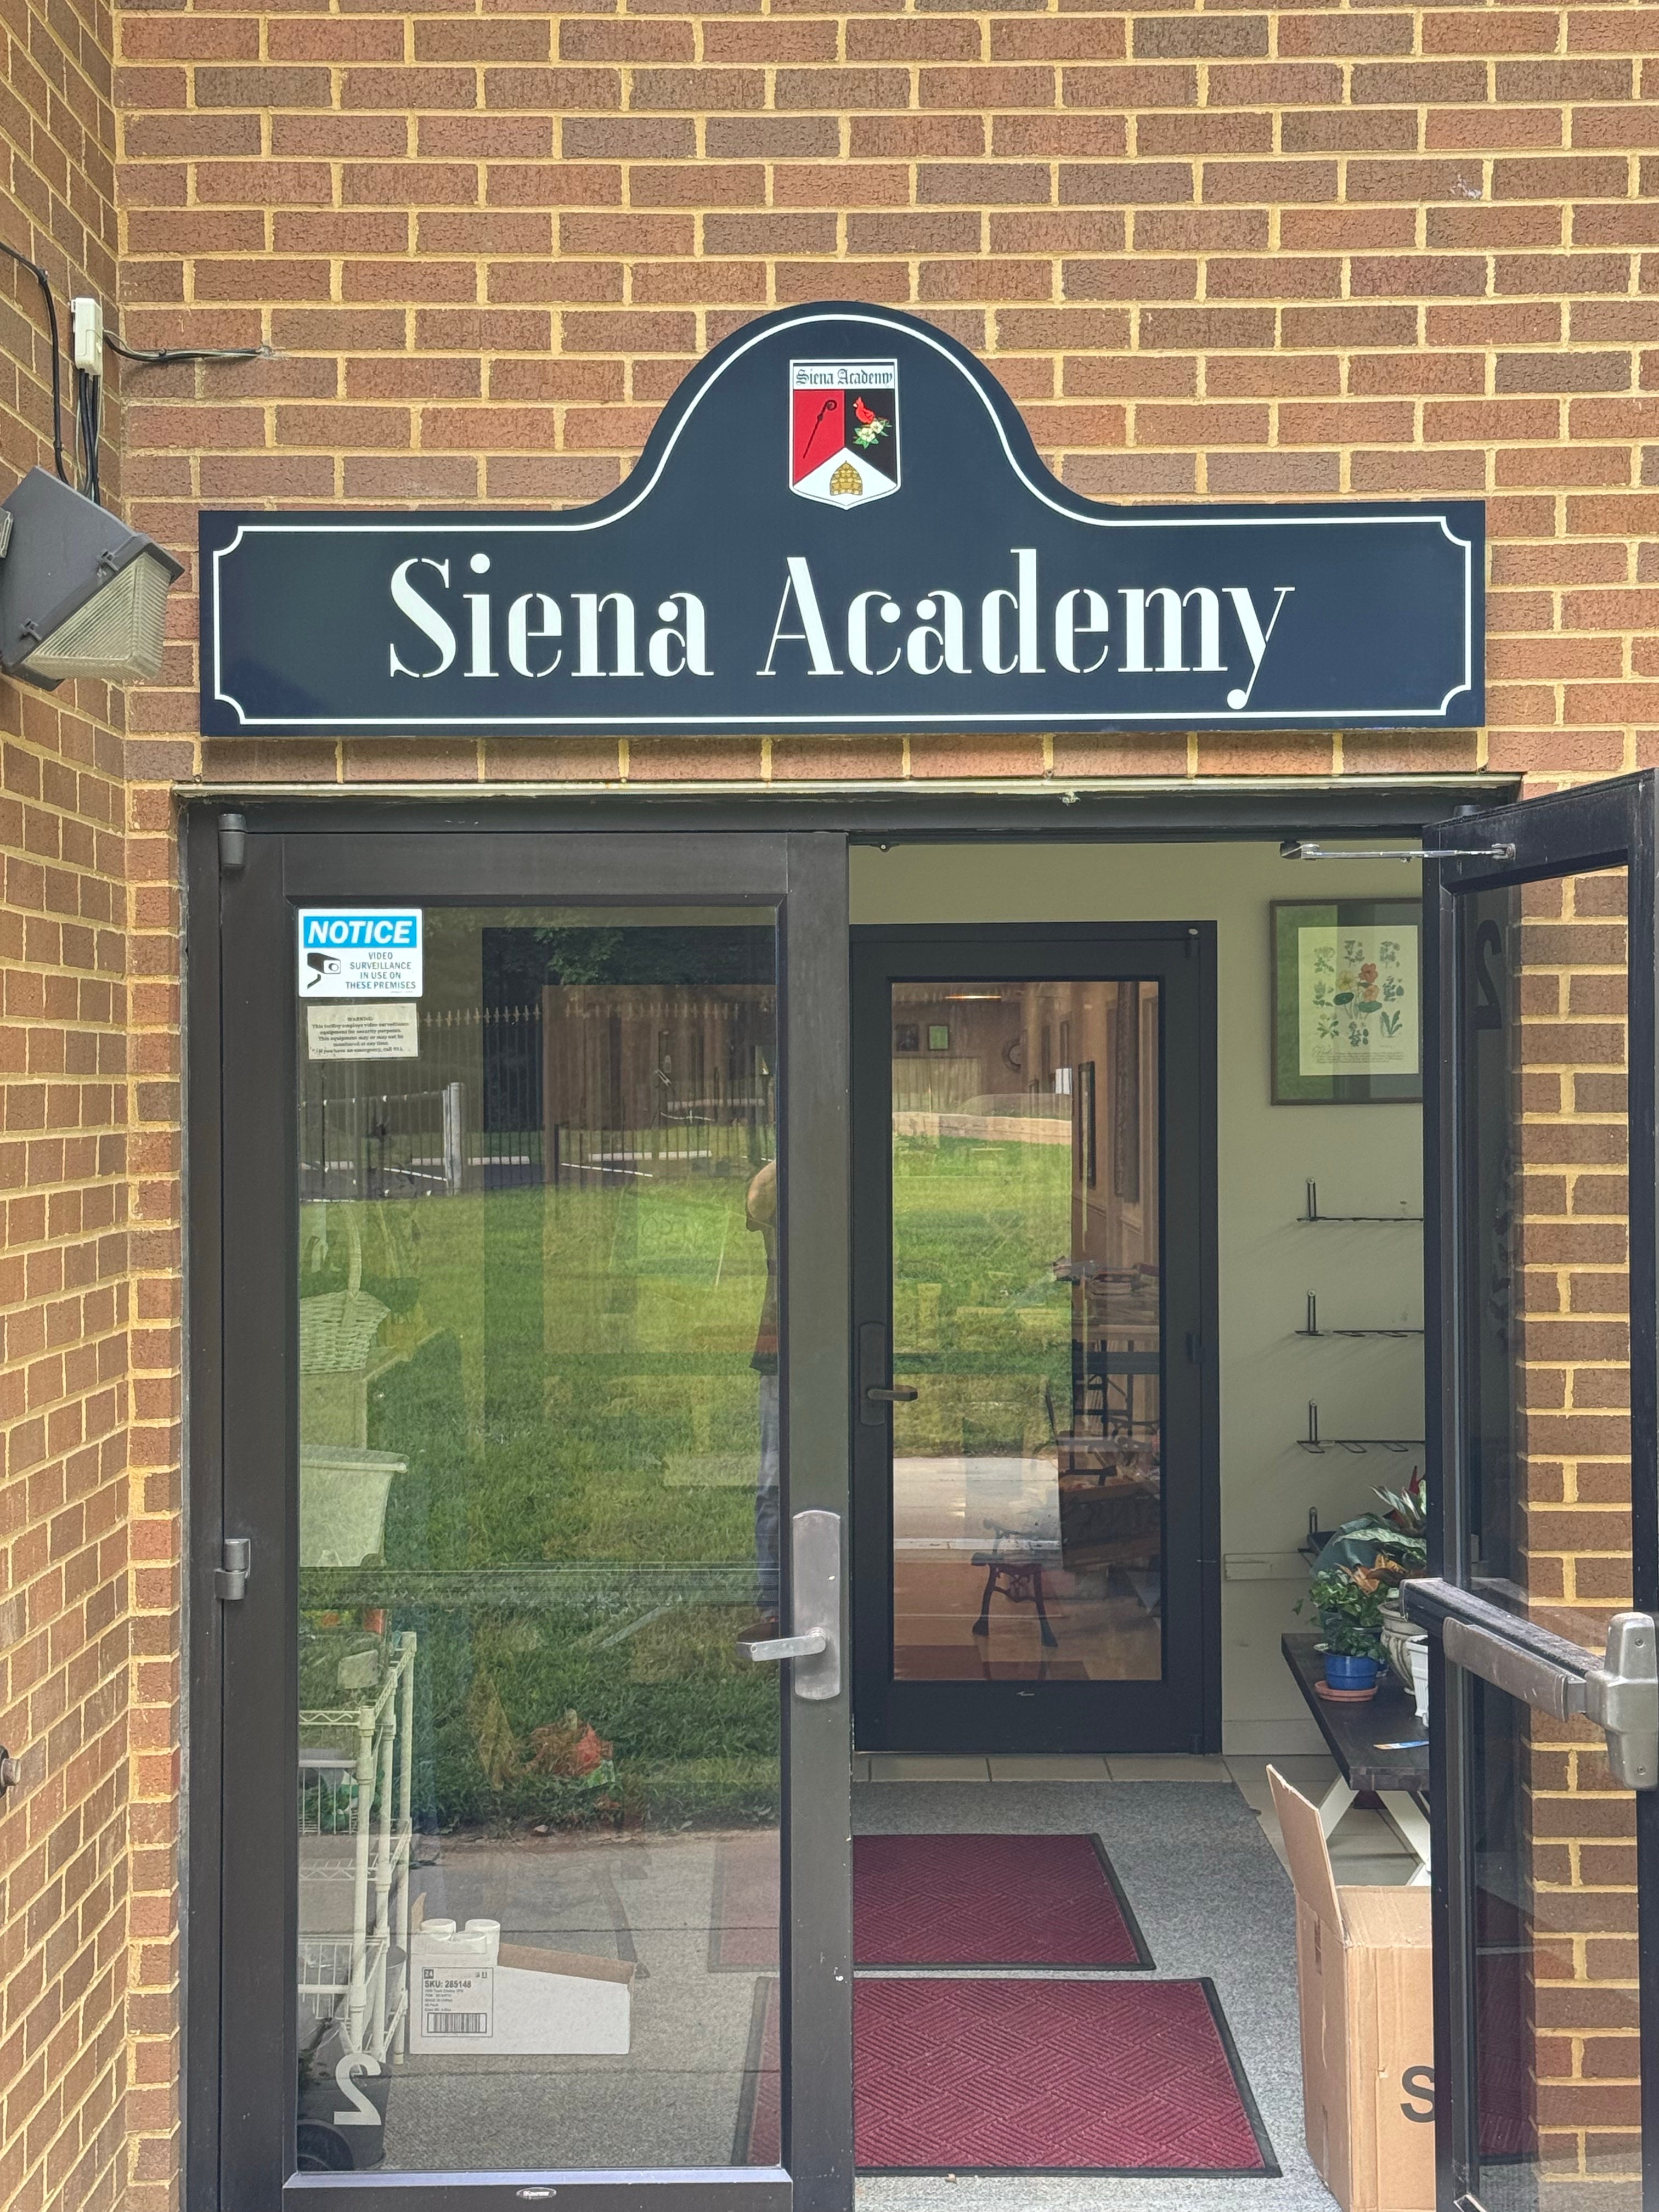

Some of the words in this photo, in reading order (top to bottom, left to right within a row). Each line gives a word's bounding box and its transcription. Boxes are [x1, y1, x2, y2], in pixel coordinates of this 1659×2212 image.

[795, 368, 834, 386] Siena
[837, 368, 893, 388] Academy
[390, 552, 714, 678] Siena
[756, 549, 1295, 710] Academy
[308, 920, 413, 944] NOTICE
[374, 981, 416, 989] PREMISES
[445, 1980, 471, 1988] 285148
